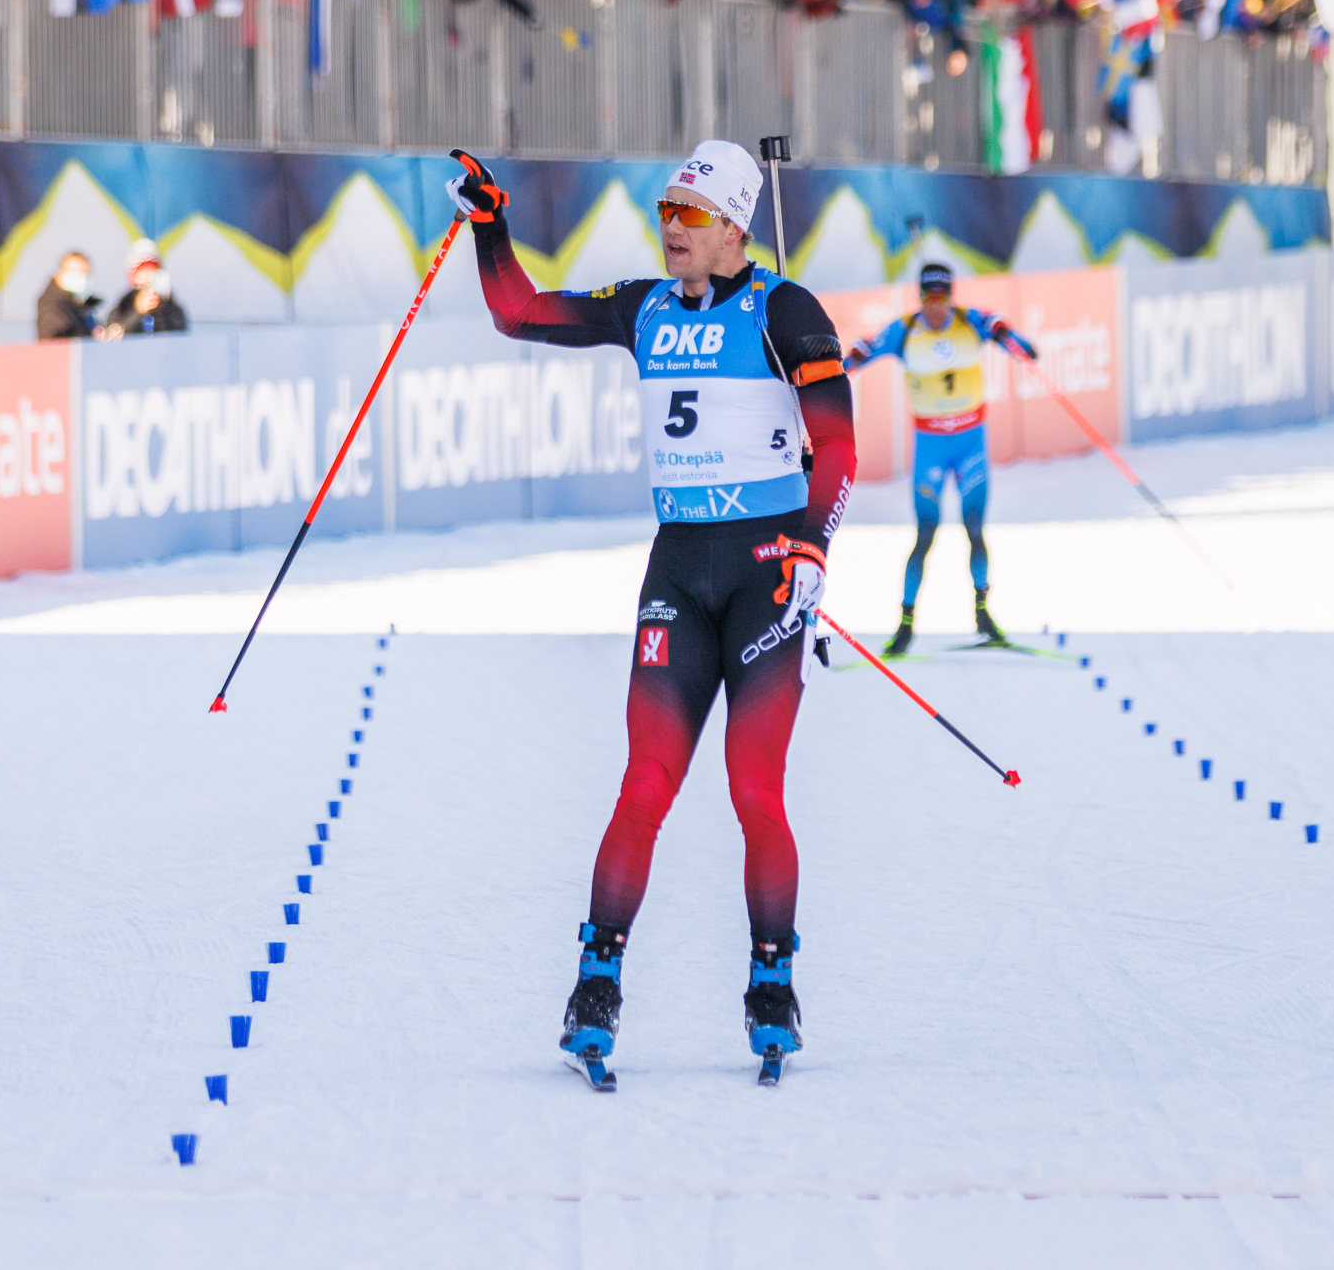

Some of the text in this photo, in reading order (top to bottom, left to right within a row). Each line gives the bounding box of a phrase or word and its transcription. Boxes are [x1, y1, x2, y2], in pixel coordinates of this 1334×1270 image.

[651, 324, 725, 355] DKB
[648, 358, 718, 370] Das kann Bank
[943, 372, 955, 395] 1
[664, 390, 699, 439] 5
[770, 429, 788, 450] 5
[668, 450, 725, 468] Otepää
[662, 471, 718, 482] visit estonia
[680, 507, 709, 519] THE
[822, 475, 854, 540] NORGE
[758, 546, 792, 558] MEN
[741, 616, 803, 665] odlo
